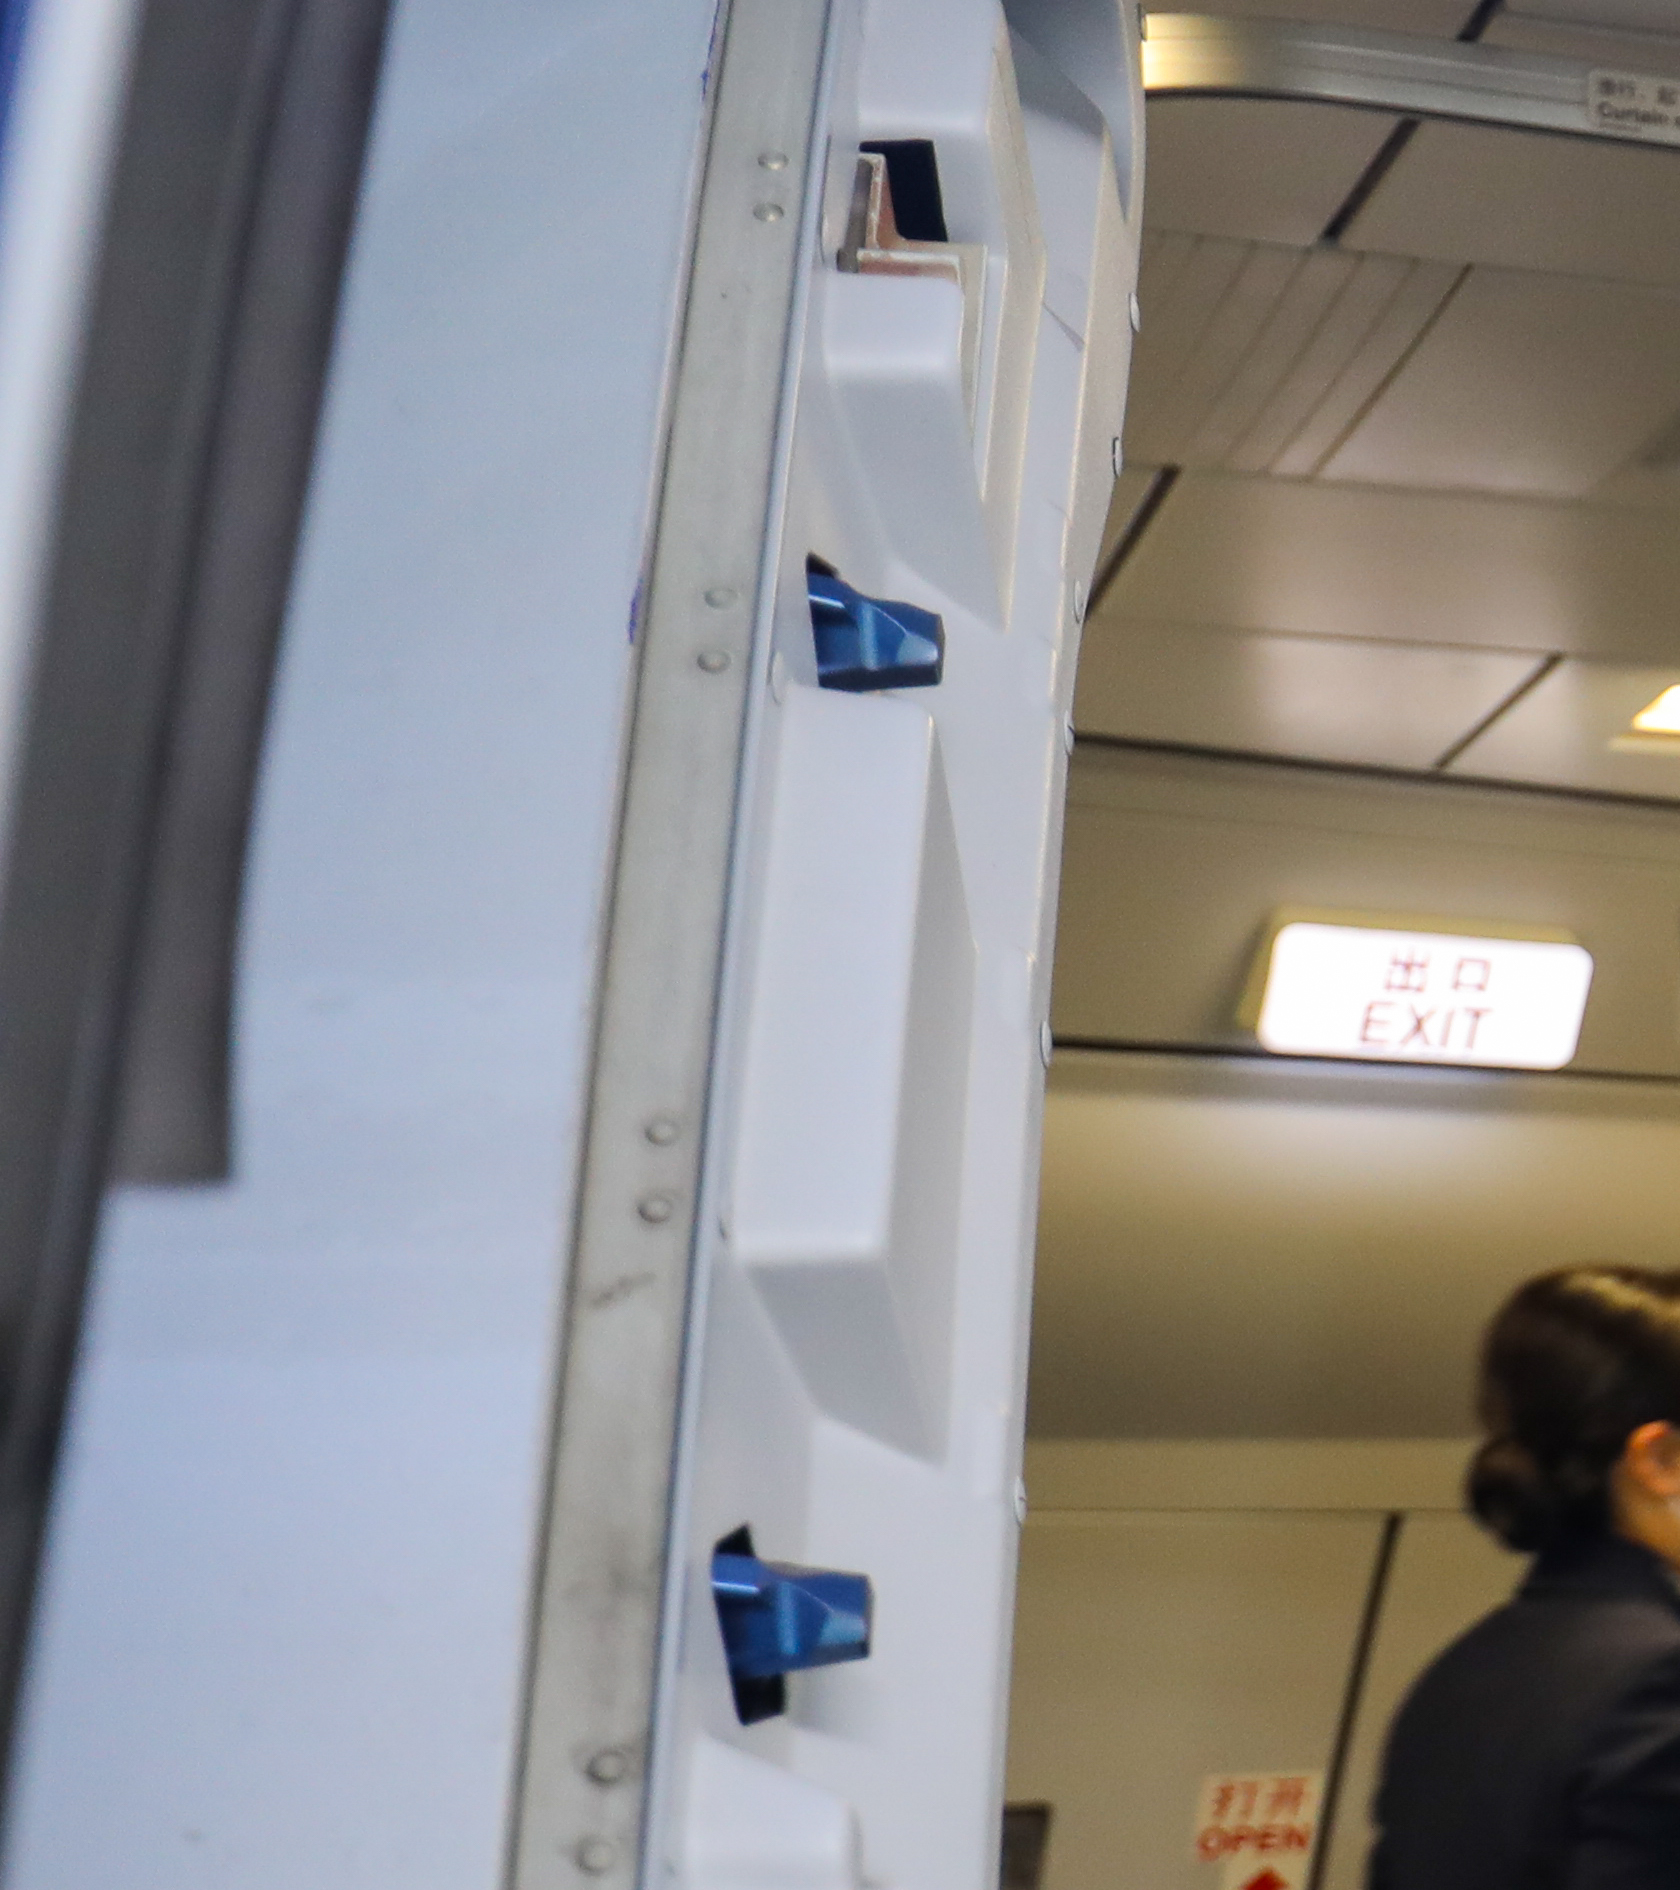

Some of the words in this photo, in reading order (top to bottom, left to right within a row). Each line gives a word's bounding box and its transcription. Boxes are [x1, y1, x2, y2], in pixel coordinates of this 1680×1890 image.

[1598, 101, 1669, 126] Curtain
[1384, 946, 1492, 992] 出口
[1360, 1000, 1494, 1050] EXIT
[1212, 1777, 1308, 1819] 打开
[1198, 1824, 1312, 1862] OPEN
